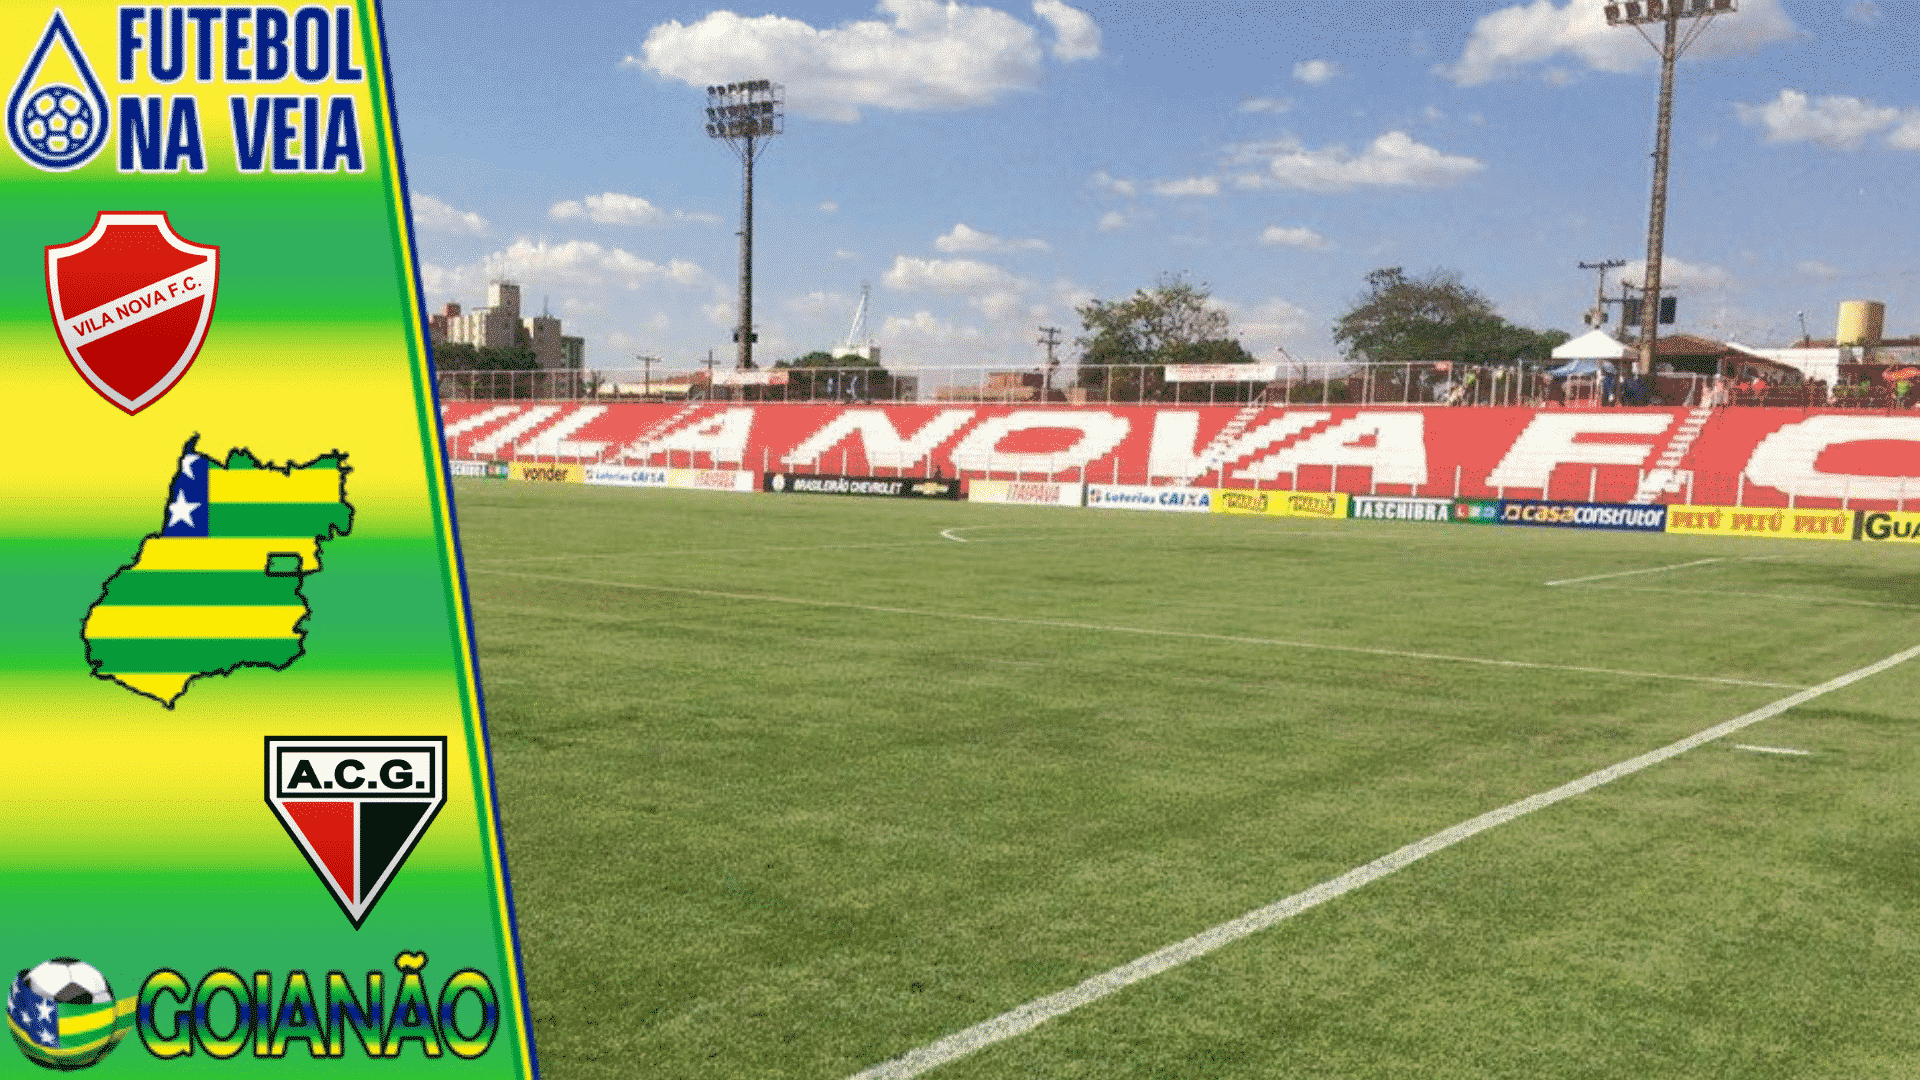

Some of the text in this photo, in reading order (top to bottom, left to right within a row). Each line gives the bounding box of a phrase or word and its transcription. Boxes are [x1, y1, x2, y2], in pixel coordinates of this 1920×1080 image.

[779, 408, 1429, 485] NOVA
[522, 465, 569, 481] vonder
[1105, 490, 1156, 505] Loterias
[1159, 491, 1210, 507] CAIXA
[1353, 496, 1452, 522] TASCHIBRA
